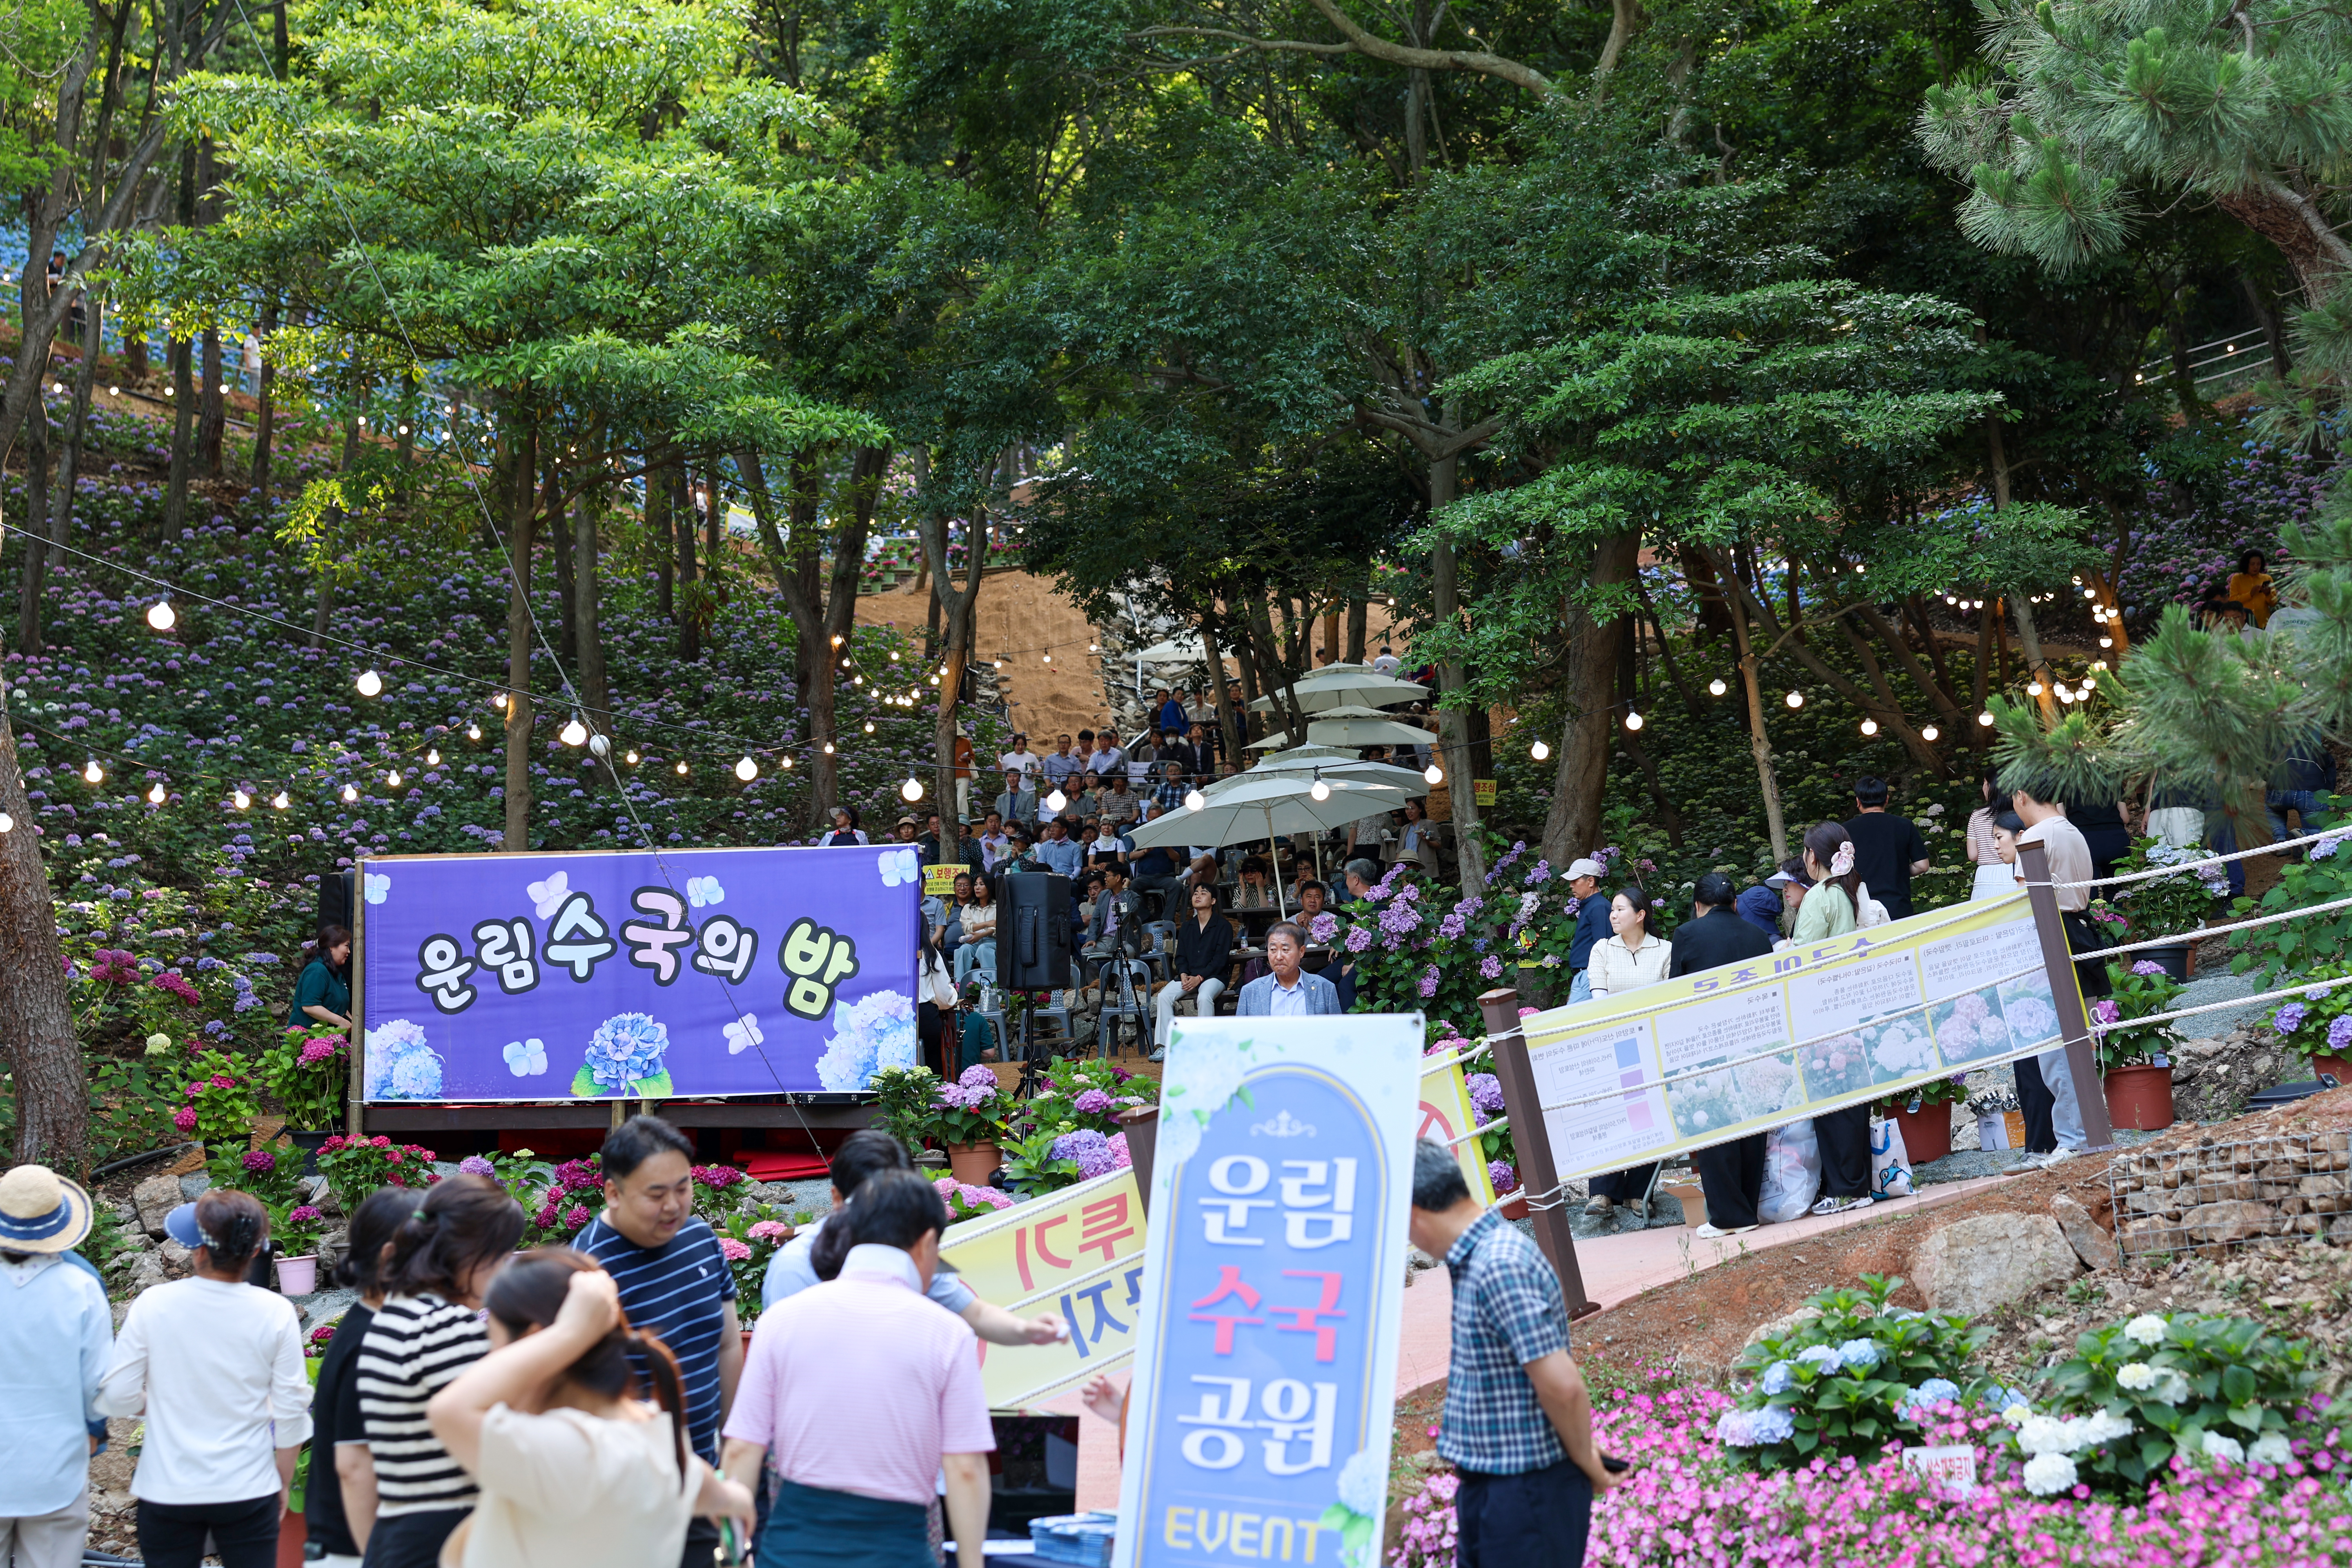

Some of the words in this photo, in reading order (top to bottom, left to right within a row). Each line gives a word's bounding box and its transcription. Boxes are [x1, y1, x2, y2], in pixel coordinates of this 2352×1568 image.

[416, 886, 758, 1014] 운림수국의
[778, 916, 859, 1020] 밤
[1198, 1154, 1358, 1250] 운림
[1188, 1265, 1347, 1362] 수국
[1176, 1374, 1338, 1476] 공원
[1163, 1506, 1326, 1564] EVENT
